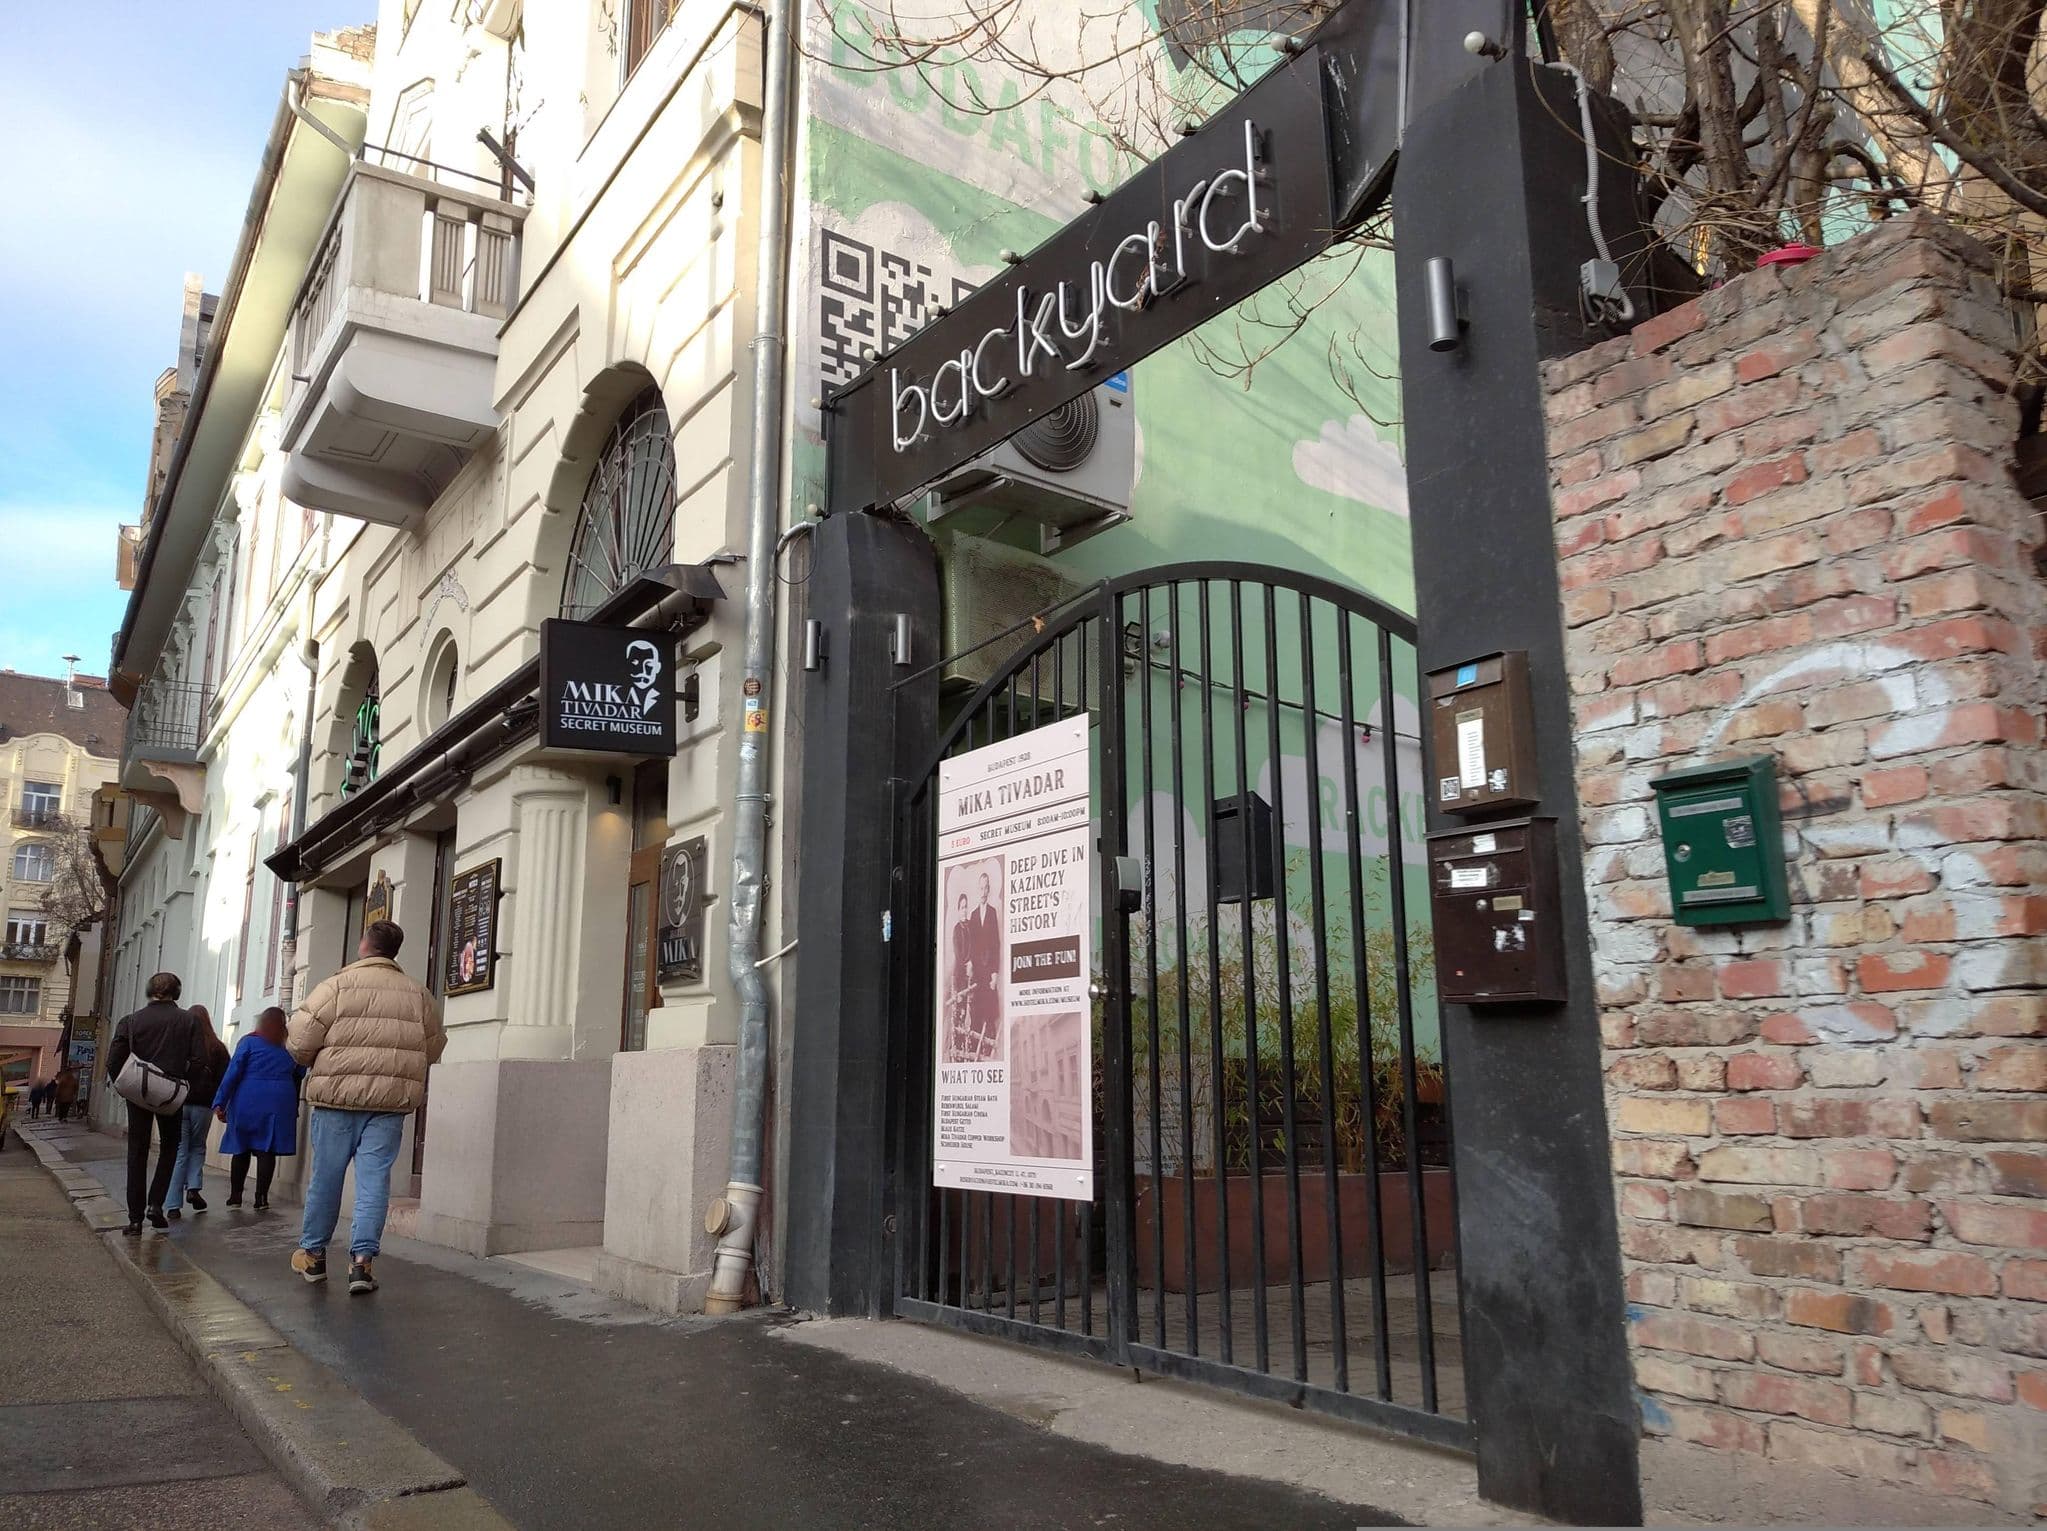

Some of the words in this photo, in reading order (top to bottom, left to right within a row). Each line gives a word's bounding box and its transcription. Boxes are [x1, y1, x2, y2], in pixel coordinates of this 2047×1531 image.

[891, 119, 1263, 452] backyard
[561, 680, 642, 705] MIKA
[560, 700, 643, 720] TIVADAR
[560, 718, 608, 732] SECRET
[609, 722, 663, 736] MUSEUM
[958, 790, 993, 817] MIKA
[998, 769, 1064, 805] TIVADAR
[979, 827, 1003, 842] SECRET
[1003, 819, 1033, 836] MUSEUM
[1010, 855, 1038, 876] DEEP
[1041, 848, 1068, 869] DIVE
[1071, 844, 1085, 863] IN
[1010, 869, 1066, 895] KAZINCZY
[1009, 911, 1059, 934] HISTORY
[1012, 954, 1034, 973] JOIN
[1033, 951, 1054, 968] THE
[941, 1069, 969, 1085] WHAT
[970, 1069, 985, 1084] TO
[986, 1068, 1005, 1084] SEE
